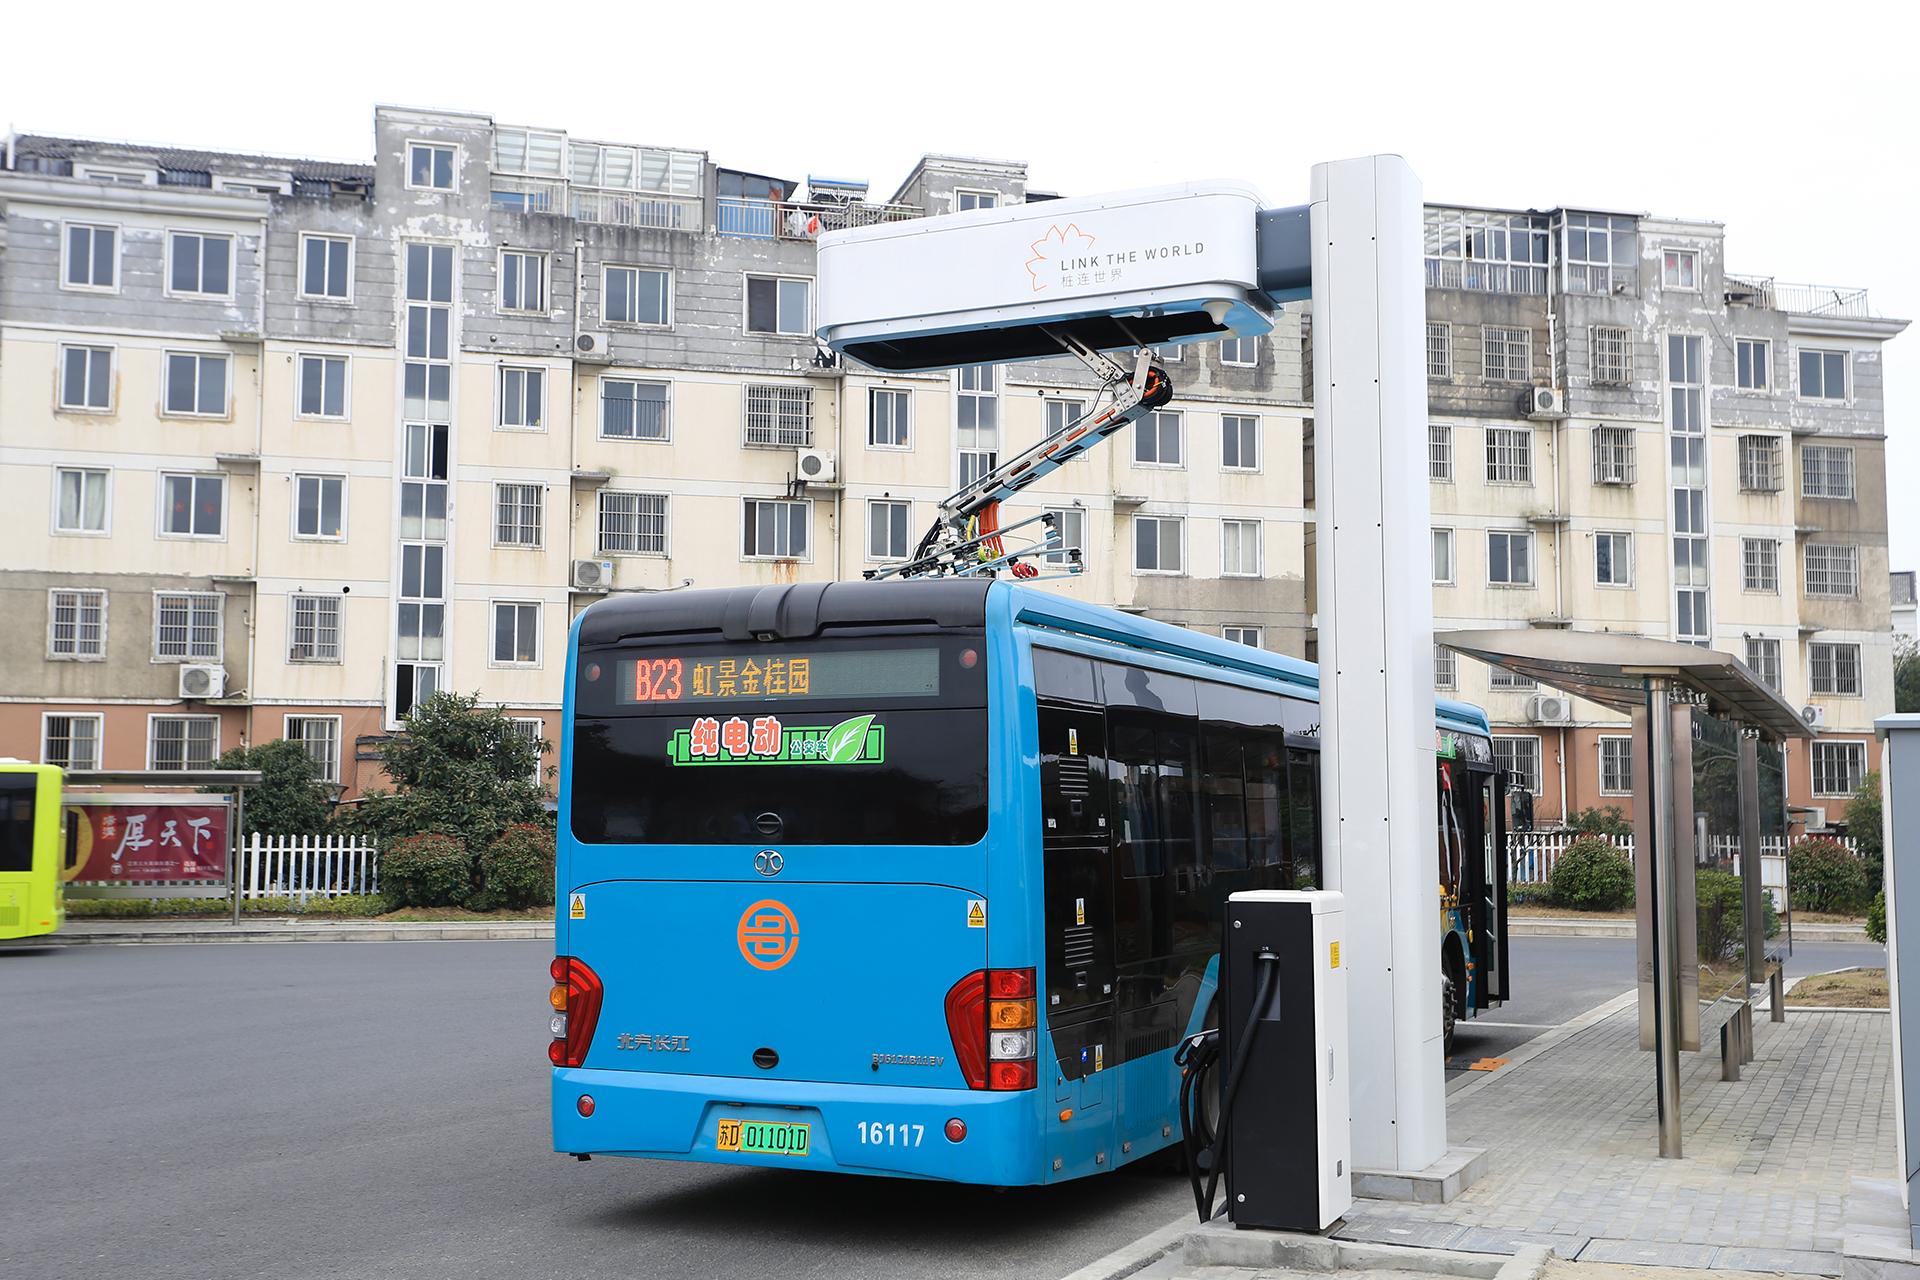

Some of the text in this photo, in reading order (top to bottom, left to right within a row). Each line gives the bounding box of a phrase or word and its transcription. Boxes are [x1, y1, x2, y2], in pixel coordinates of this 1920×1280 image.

[1061, 242, 1204, 271] LINK THE WORLD
[1061, 268, 1123, 289] 桩连世界
[636, 657, 810, 701] B23 虹景金桂园
[690, 716, 782, 757] 纯电动
[790, 739, 828, 755] 公交车
[617, 1032, 690, 1053] 北汽长江
[719, 1124, 808, 1151] 苏D 01101D
[857, 1121, 925, 1148] 16117
